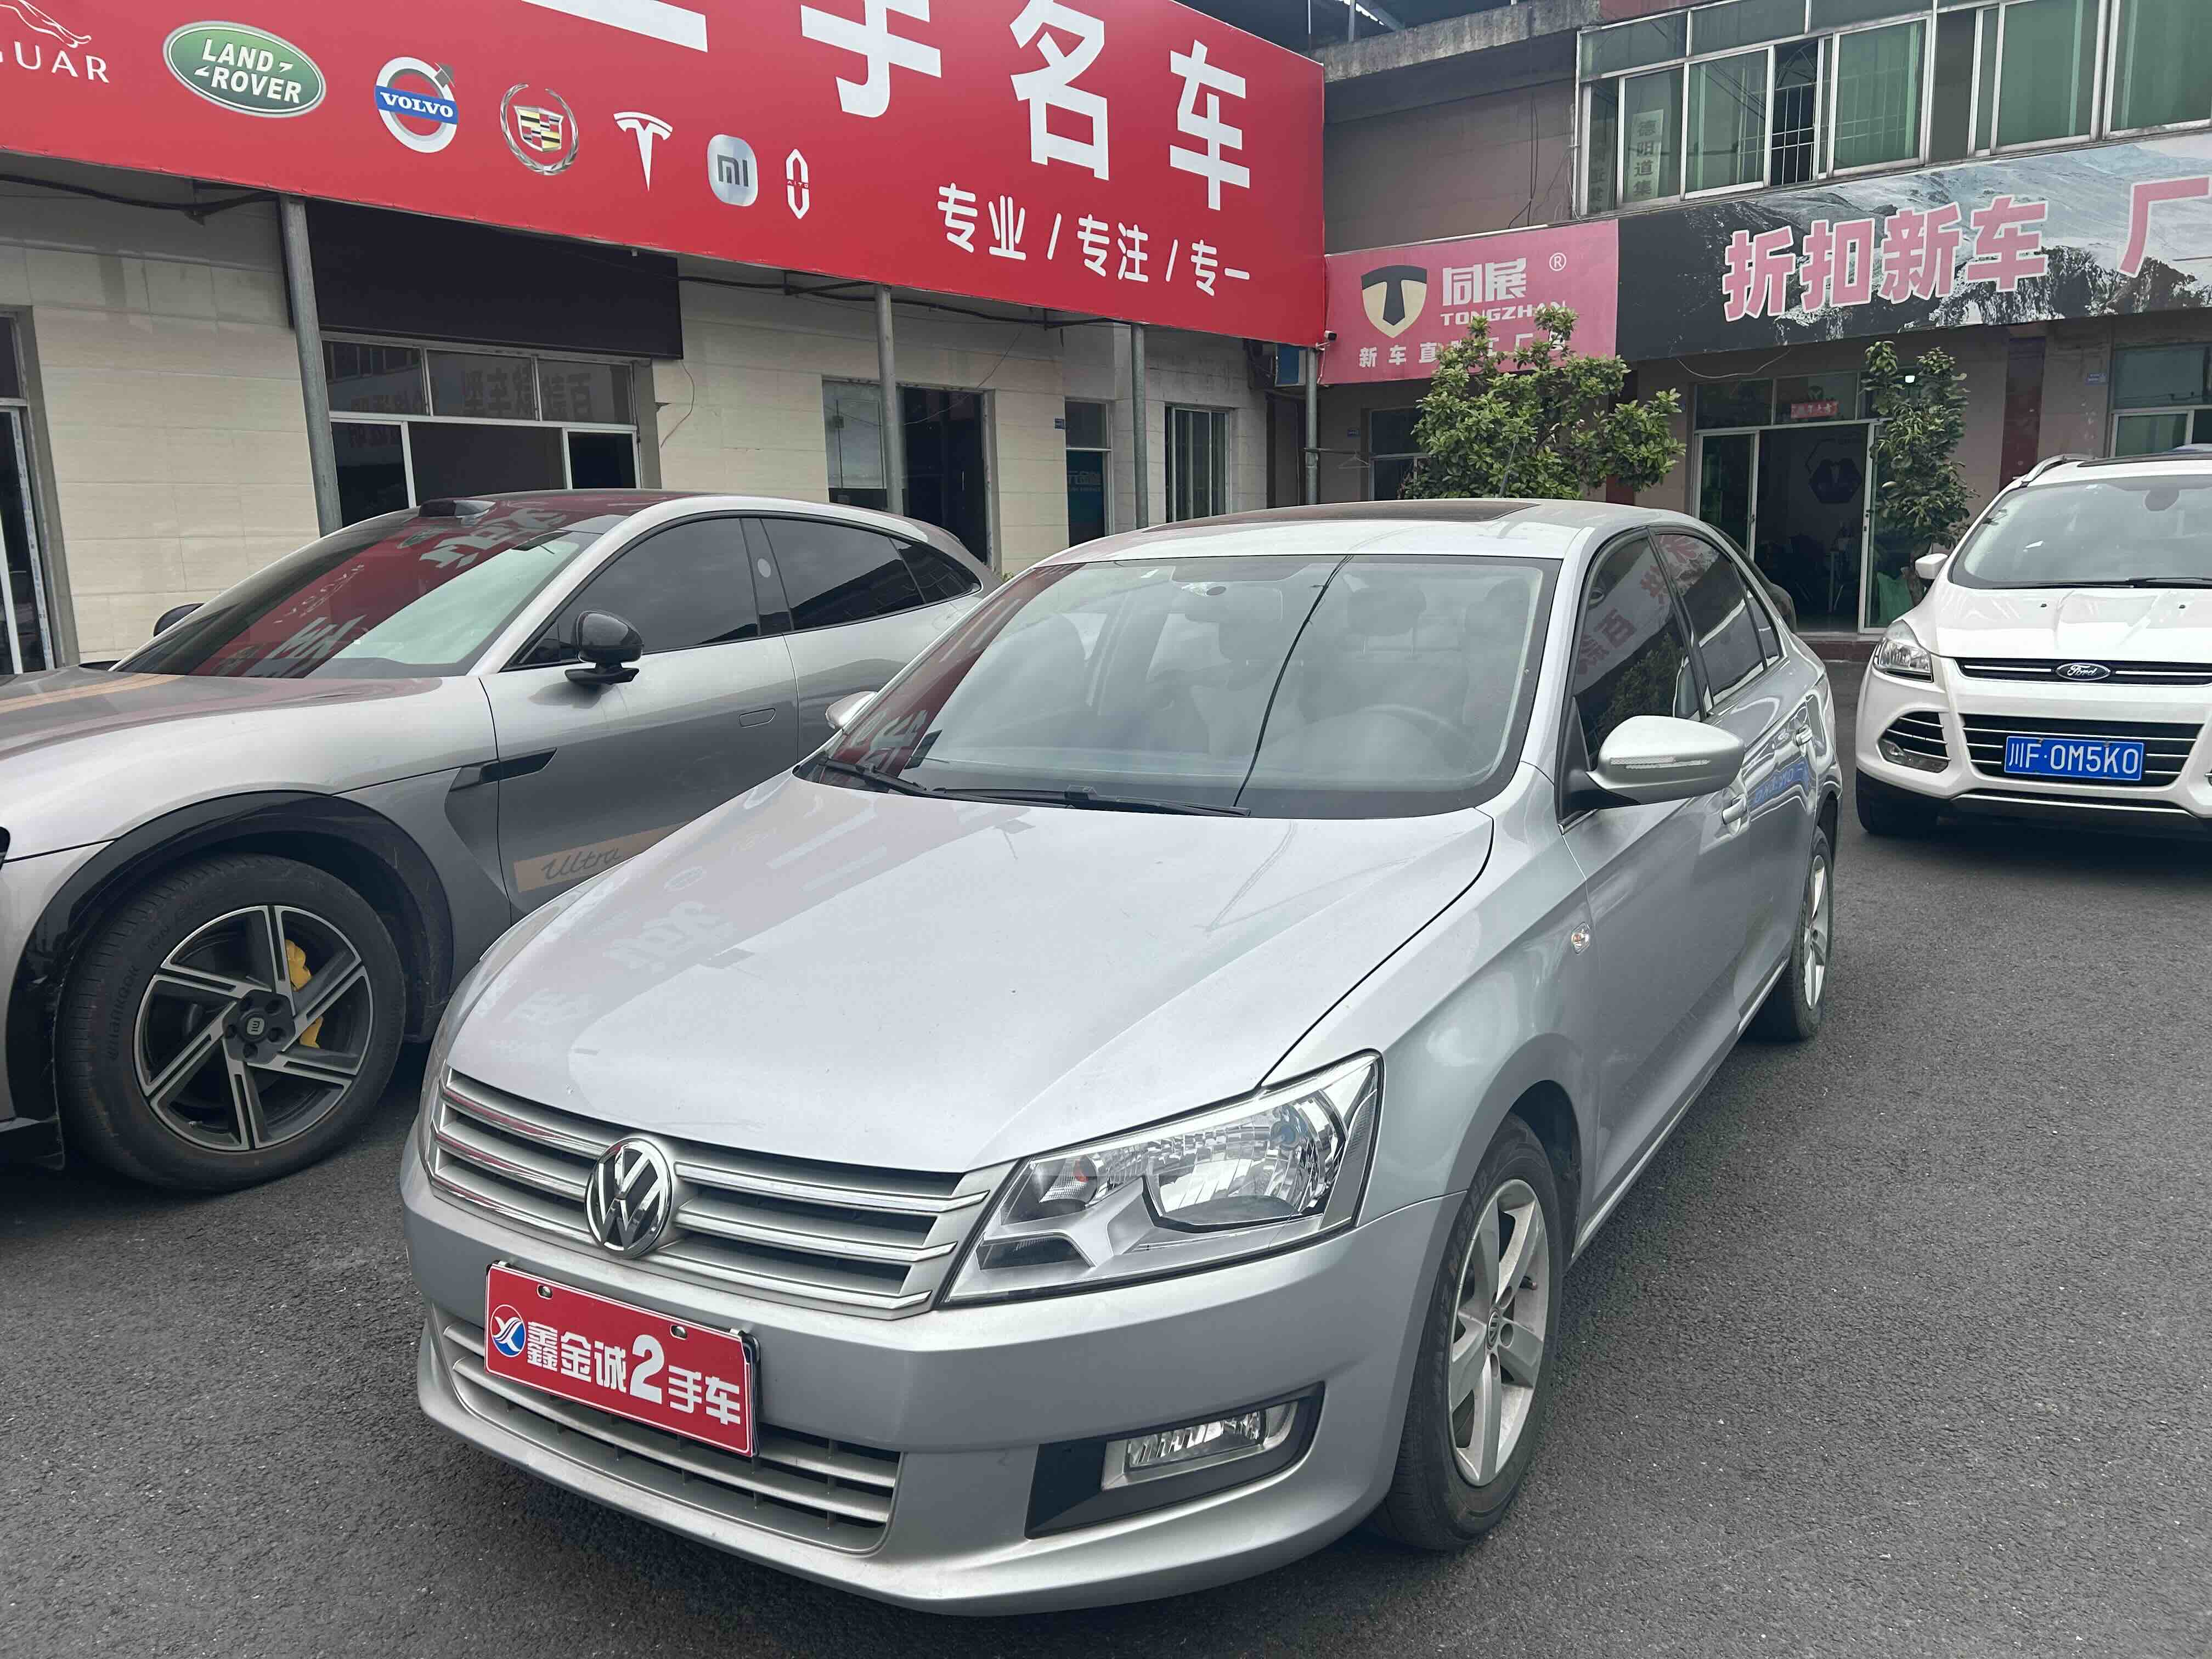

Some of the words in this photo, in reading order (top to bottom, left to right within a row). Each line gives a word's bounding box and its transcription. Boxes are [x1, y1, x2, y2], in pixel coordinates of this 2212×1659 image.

[0, 41, 110, 83] UAR
[202, 38, 274, 74] LAND
[211, 66, 302, 104] ROVER
[380, 92, 454, 119] VOLVO
[1722, 195, 2049, 321] 折扣新车
[1442, 257, 1527, 306] 同展
[2067, 664, 2097, 676] Ford
[541, 848, 621, 879] Ultra
[527, 1321, 741, 1425] 鑫金诚2手车
